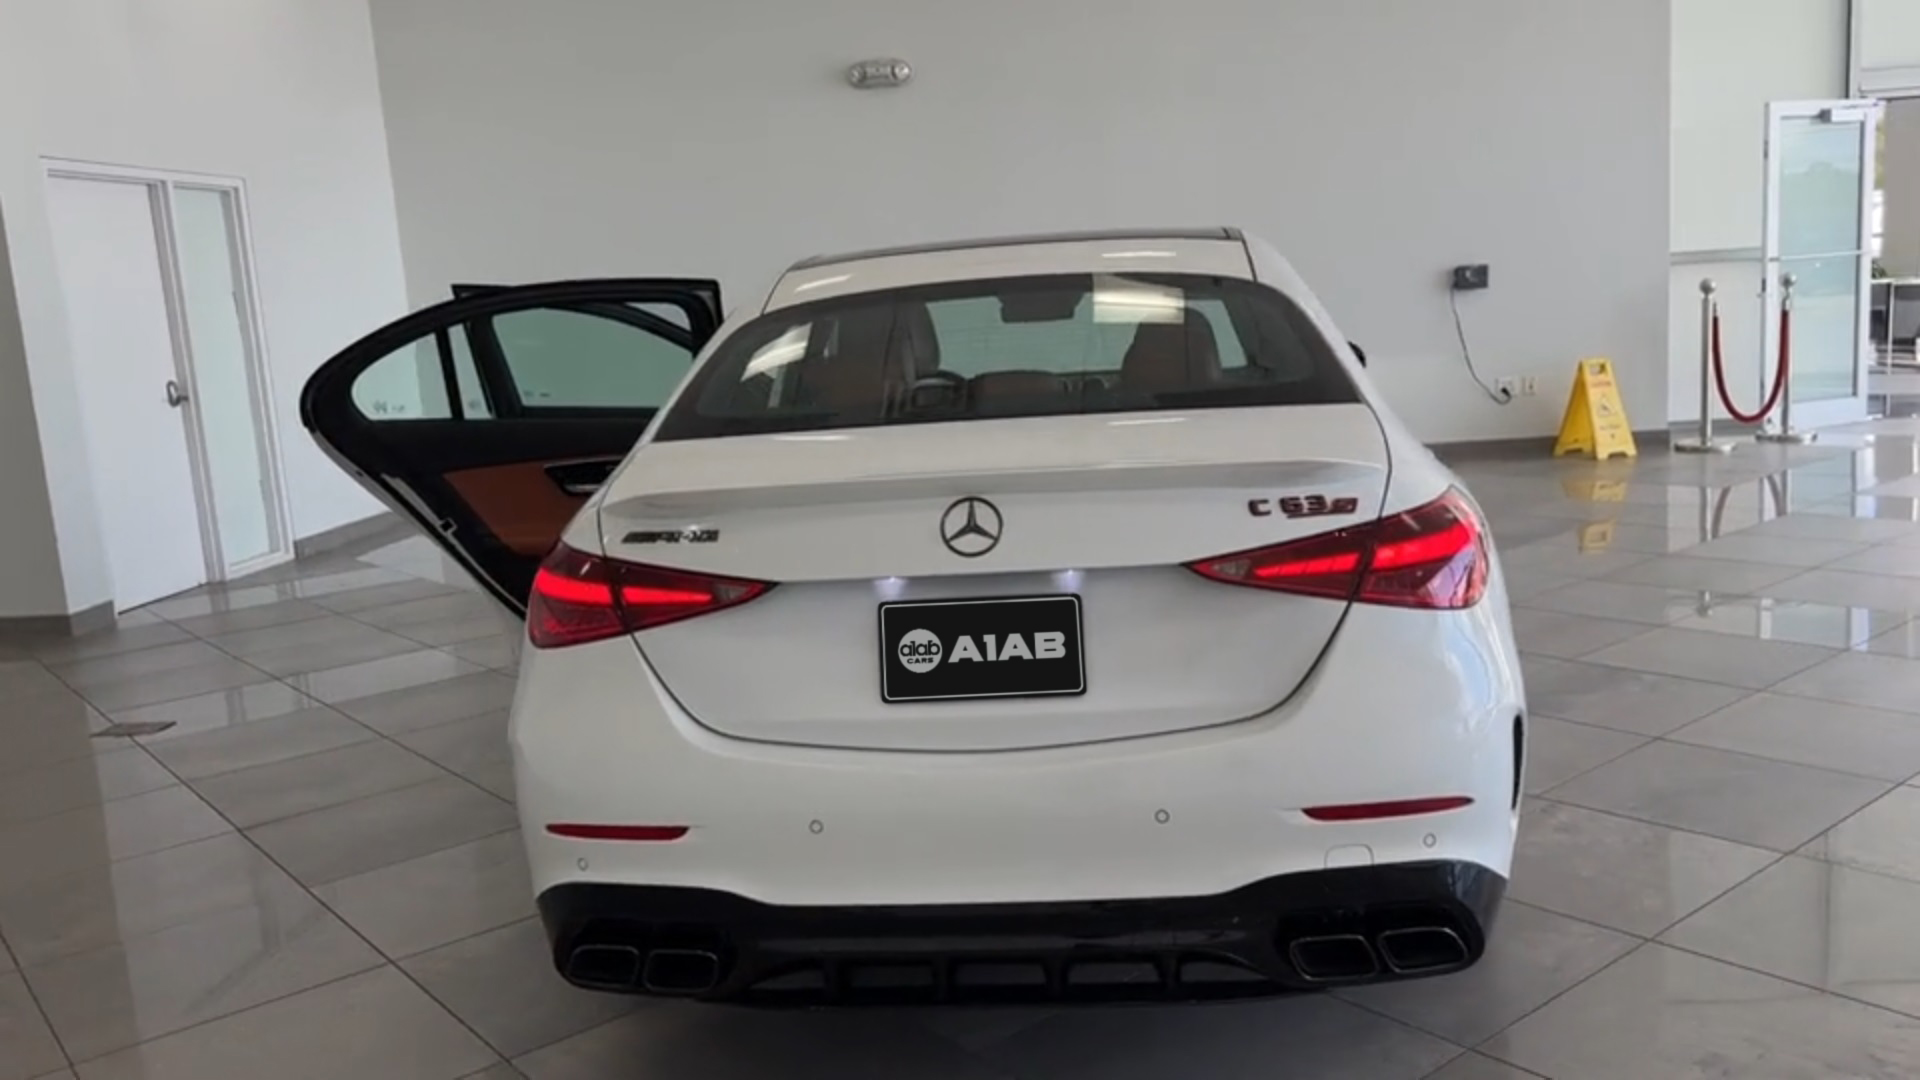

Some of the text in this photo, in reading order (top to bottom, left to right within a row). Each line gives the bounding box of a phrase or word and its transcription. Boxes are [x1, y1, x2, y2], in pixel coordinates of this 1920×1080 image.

[1248, 498, 1272, 517] C
[1279, 494, 1329, 515] 63
[948, 631, 1066, 663] A1AB
[906, 657, 934, 665] CARS
